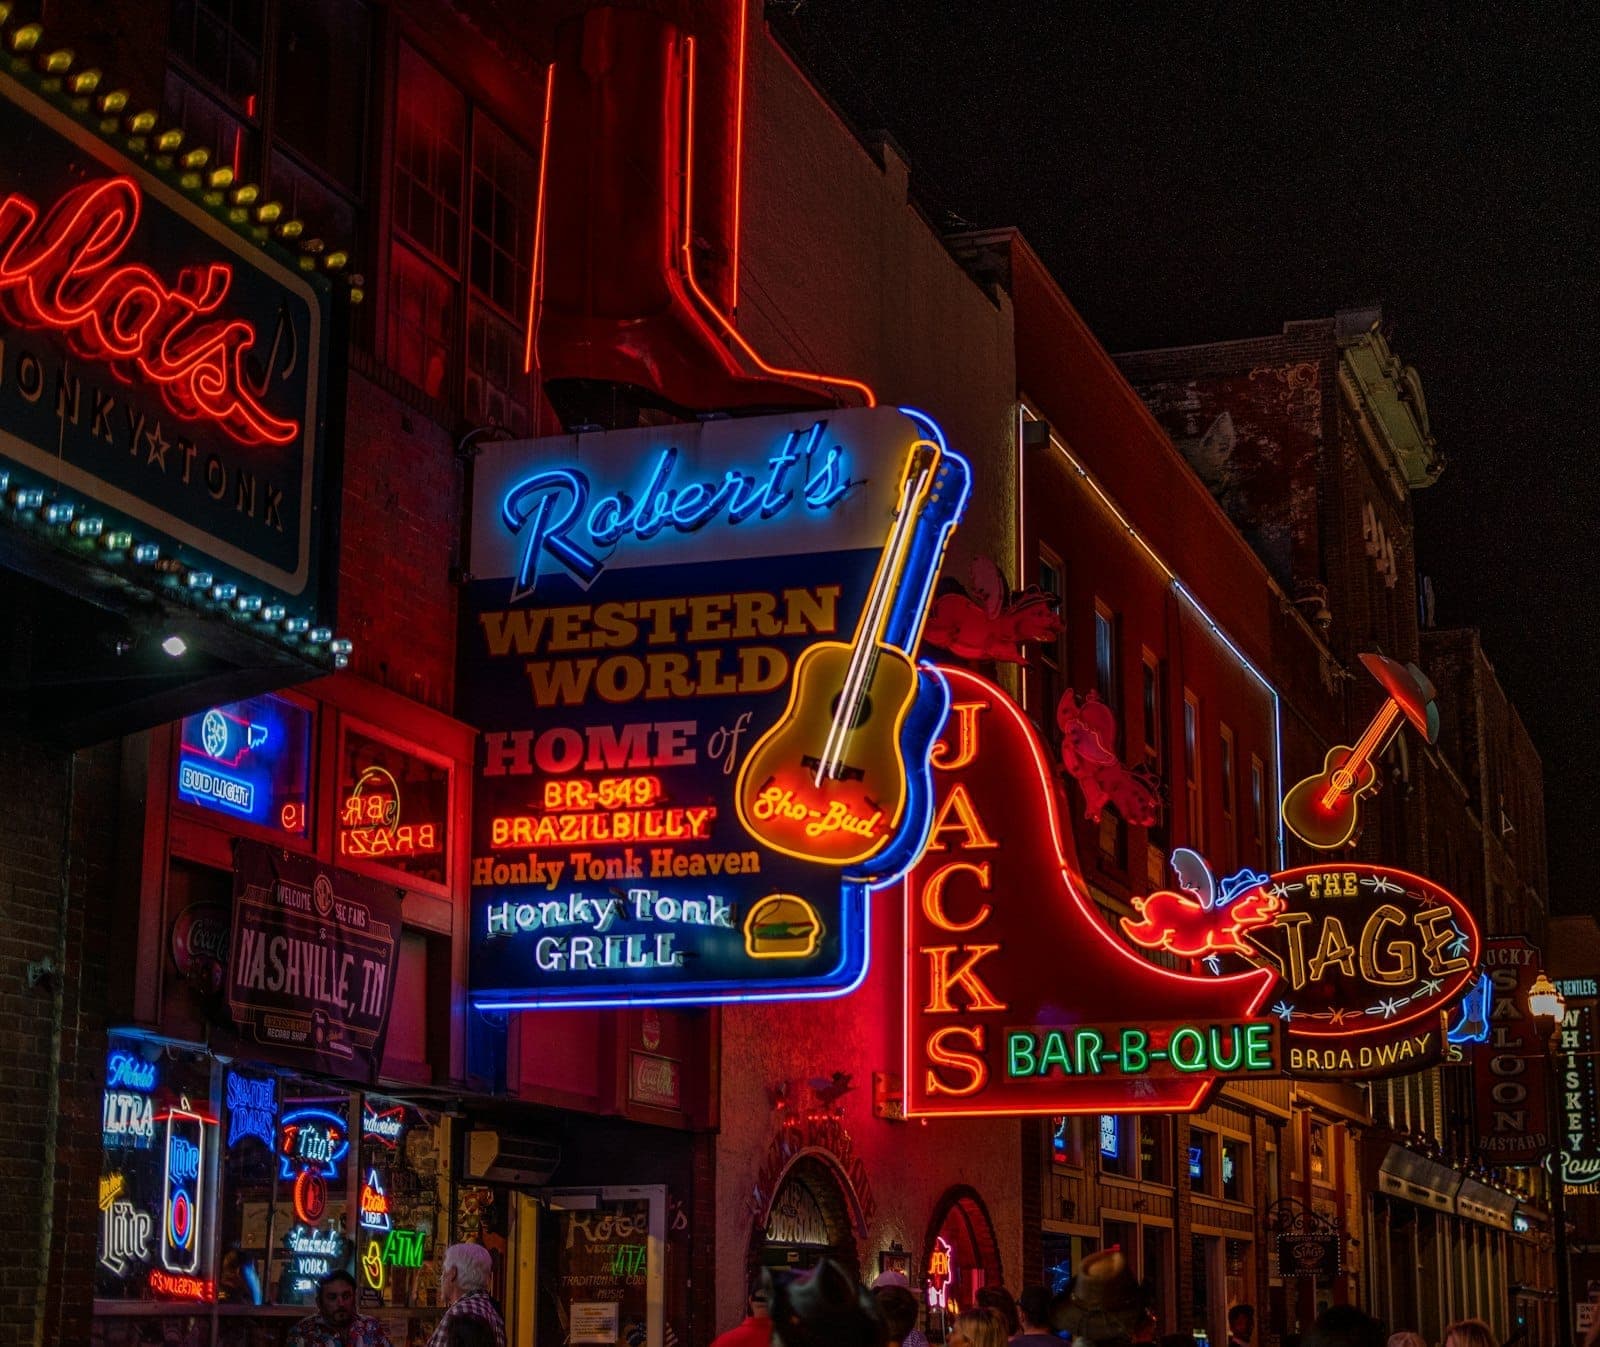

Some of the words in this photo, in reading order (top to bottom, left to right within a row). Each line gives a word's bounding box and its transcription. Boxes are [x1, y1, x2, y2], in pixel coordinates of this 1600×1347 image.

[177, 436, 285, 535] TONK
[502, 418, 850, 600] Robert's
[480, 584, 842, 658] WESTERN
[526, 645, 791, 710] WORLD
[483, 720, 698, 778] HOME
[706, 711, 754, 775] of
[183, 767, 212, 794] BUD
[212, 777, 250, 807] LIGHT
[543, 775, 660, 812] BR-549
[491, 808, 714, 848] BRAZILBILLY
[753, 786, 884, 840] Sho-Bud
[472, 855, 565, 889] Honky
[569, 850, 644, 882] Tonk
[649, 848, 761, 879] Heaven
[1305, 872, 1360, 898] THE
[276, 884, 312, 912] WELCOME
[334, 905, 347, 922] SEC
[348, 908, 367, 928] FANS
[486, 891, 620, 937] Honky
[628, 887, 735, 931] Tonk
[920, 701, 1007, 1097] JACKS
[535, 932, 682, 973] GRILL
[359, 959, 387, 1017] TN
[1006, 1022, 1273, 1078] BAR-B-QUE
[1290, 1032, 1431, 1070] BROADWAY
[1488, 968, 1529, 1134] SALOON
[1560, 1009, 1585, 1152] WHISKEY
[168, 1134, 200, 1185] Lite
[298, 1125, 336, 1163] Tito's
[1478, 1133, 1547, 1151] BASTARD
[99, 1201, 151, 1274] Lite
[382, 1228, 427, 1269] ATM
[298, 1257, 328, 1275] VODKA
